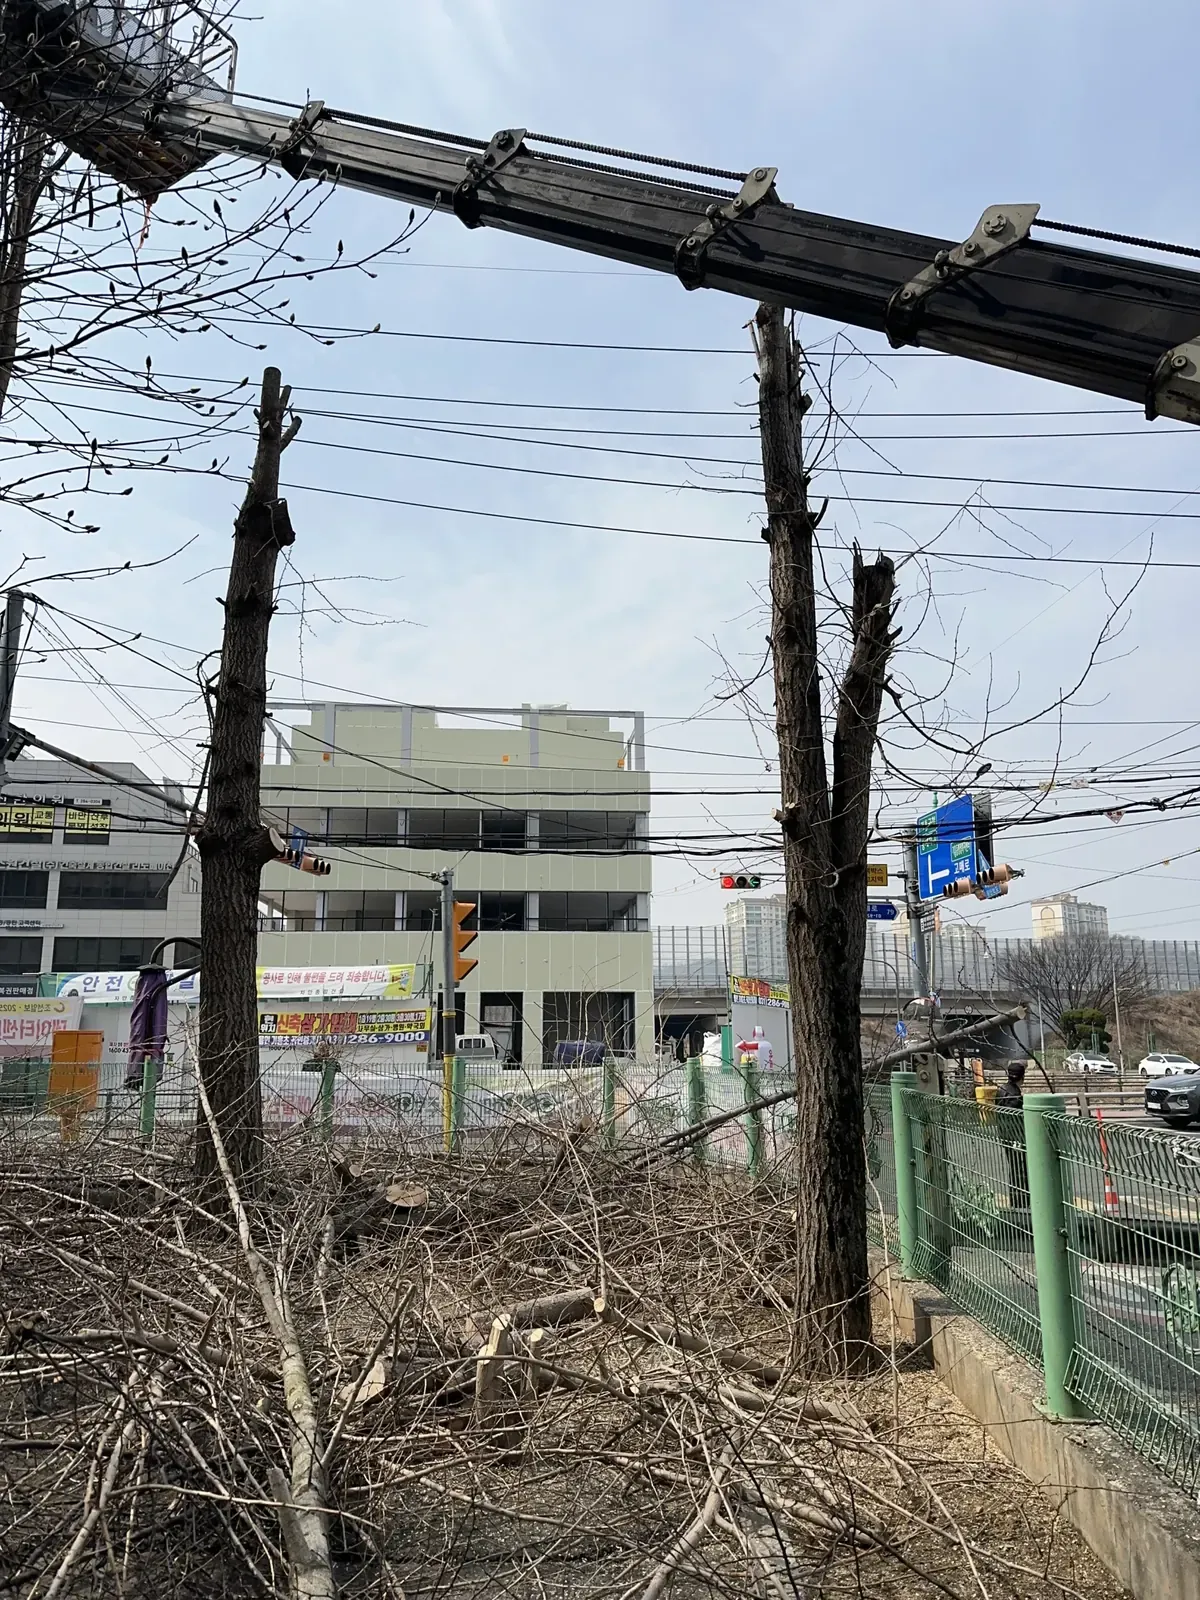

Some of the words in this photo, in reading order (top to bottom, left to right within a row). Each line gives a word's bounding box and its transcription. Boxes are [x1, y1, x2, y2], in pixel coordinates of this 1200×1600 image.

[263, 972, 284, 985] 공사로
[287, 972, 302, 984] 인해
[303, 972, 326, 983] 불편을
[328, 971, 344, 983] 드려
[346, 971, 387, 983] 죄송합니다.
